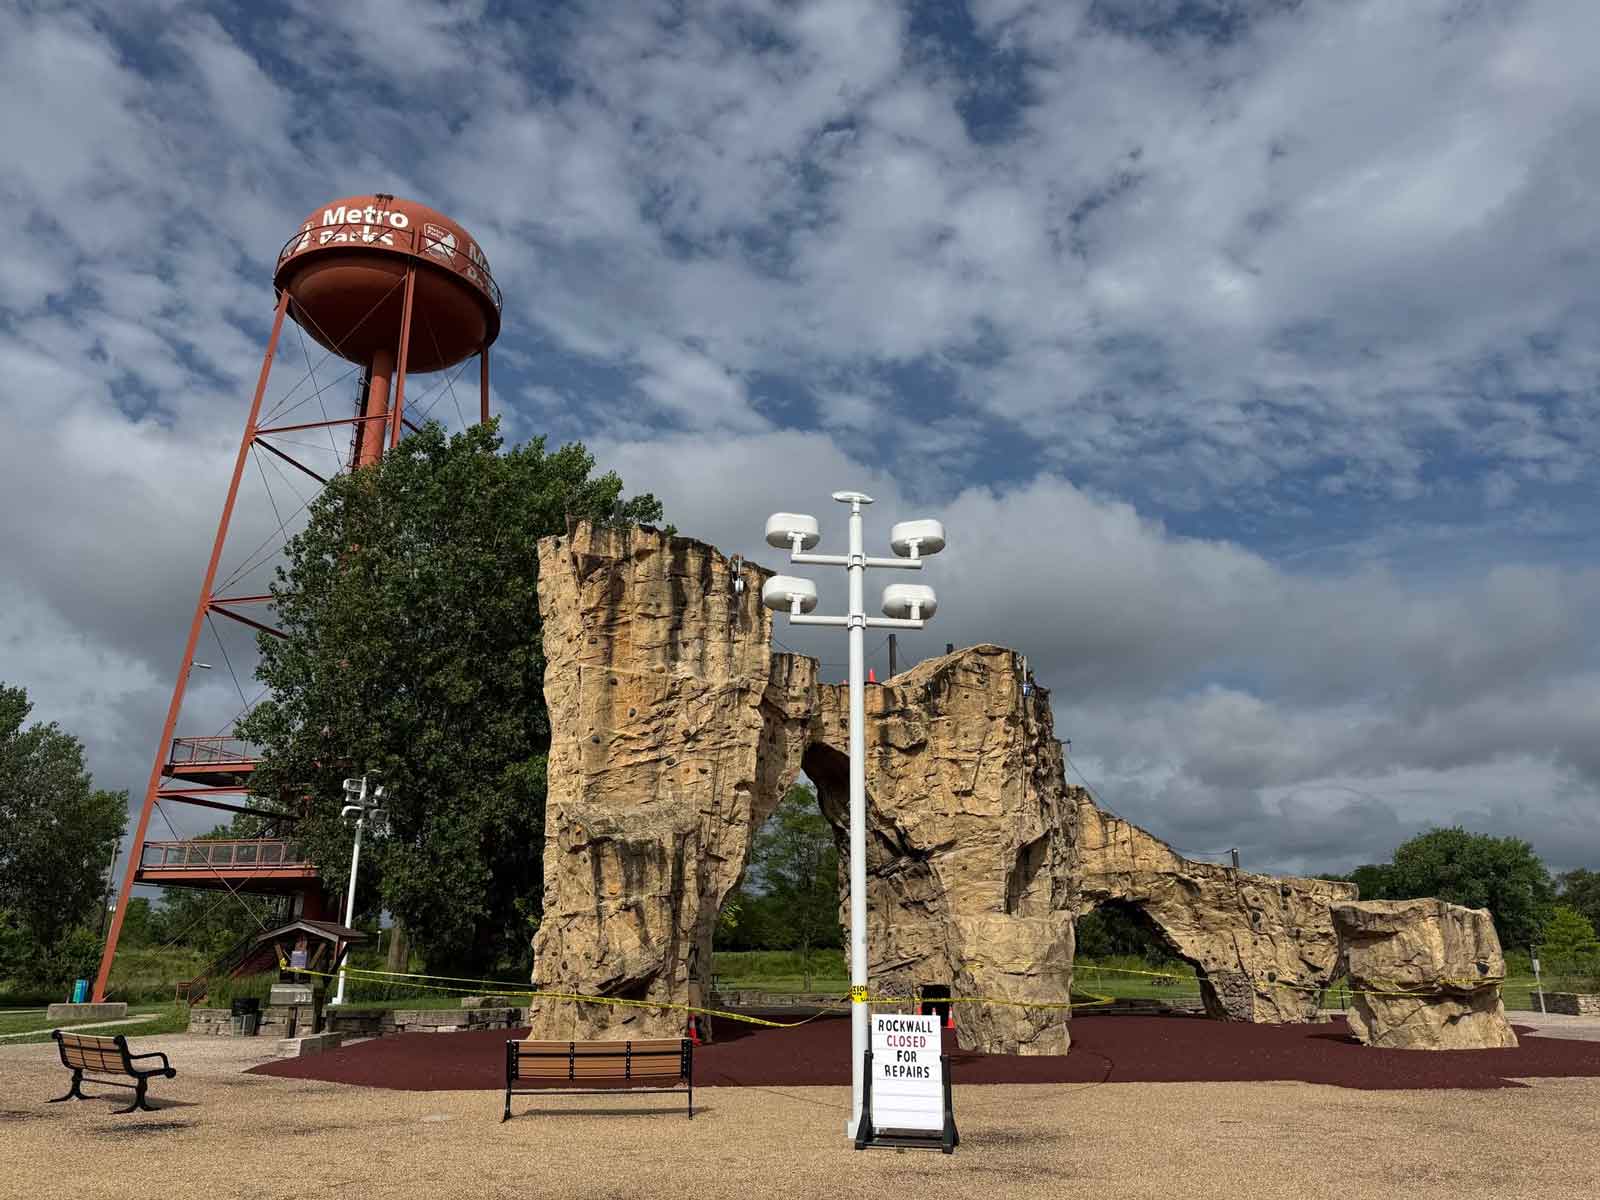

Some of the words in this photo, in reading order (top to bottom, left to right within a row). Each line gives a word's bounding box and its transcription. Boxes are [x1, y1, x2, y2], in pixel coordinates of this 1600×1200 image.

[322, 205, 409, 228] Metro
[878, 1019, 933, 1033] ROCKWALL
[886, 1034, 927, 1048] CLOSED
[896, 1050, 917, 1063] FOR
[884, 1064, 930, 1078] REPAIRS
